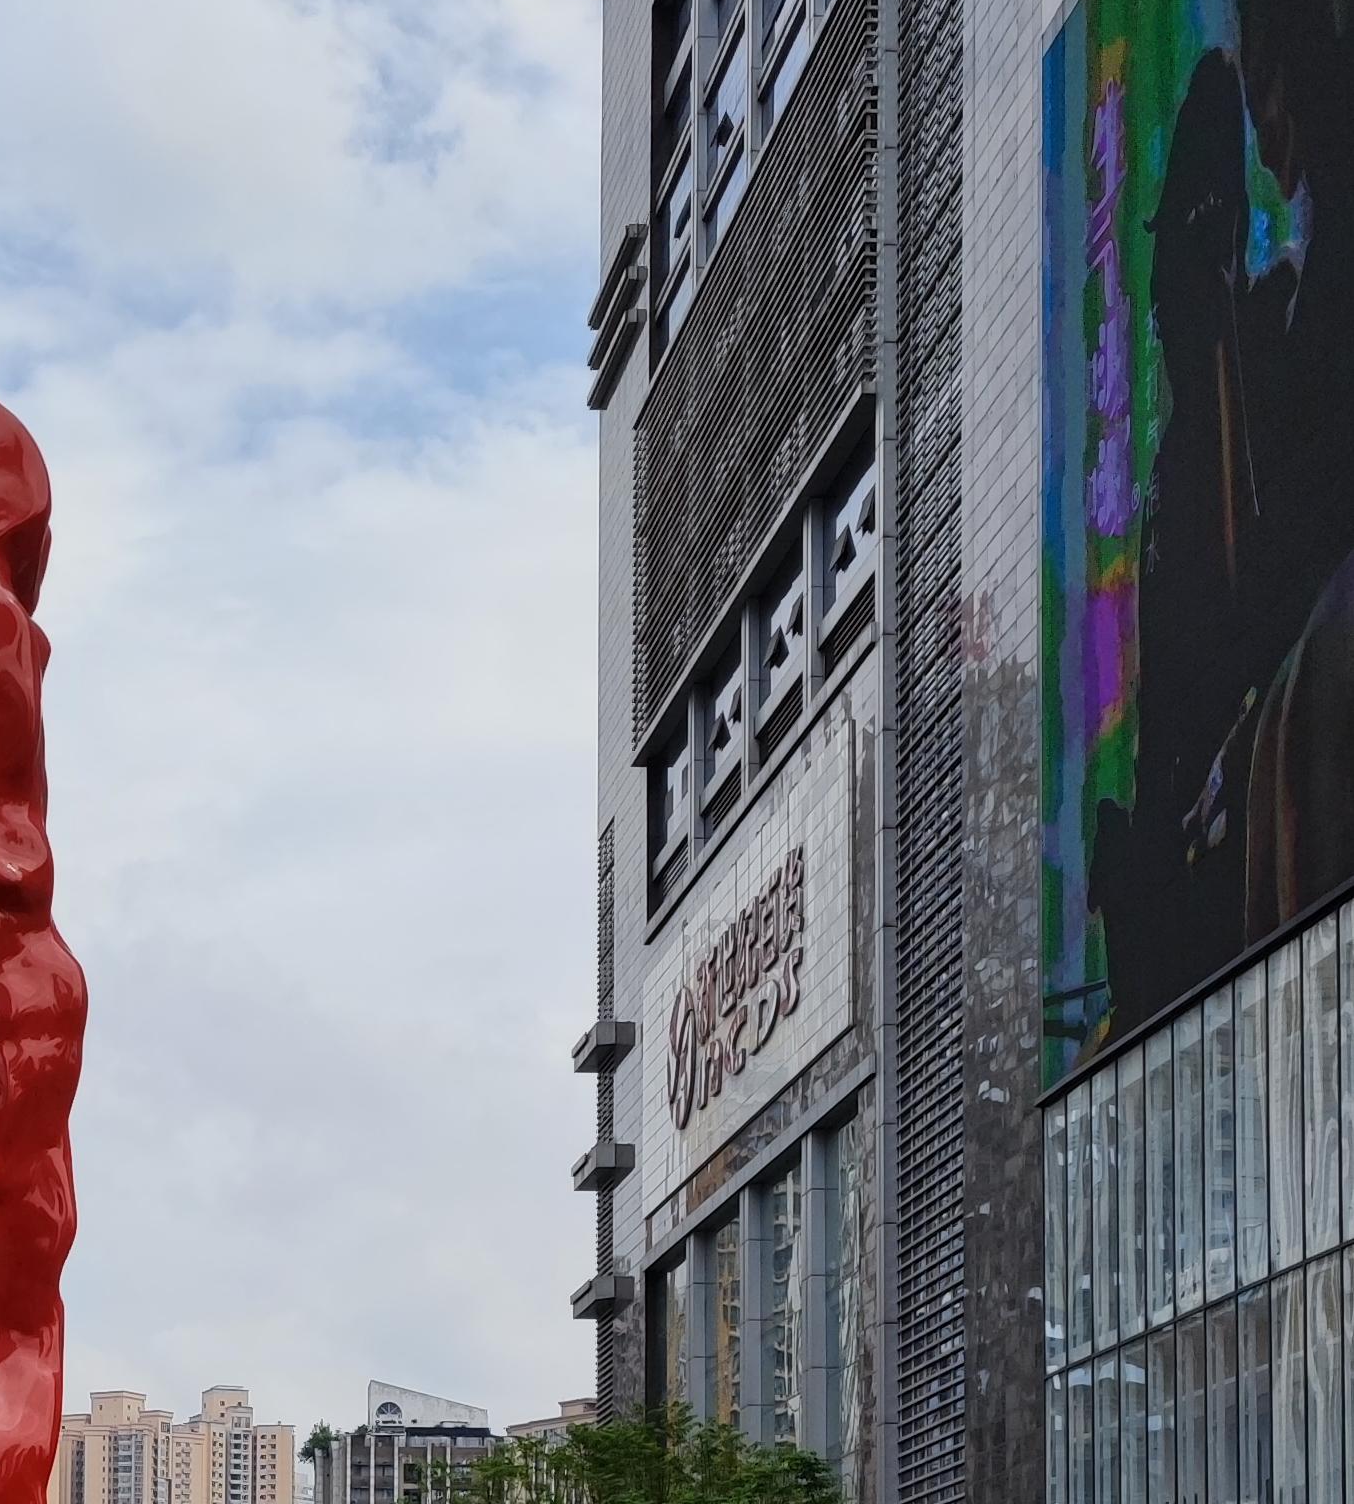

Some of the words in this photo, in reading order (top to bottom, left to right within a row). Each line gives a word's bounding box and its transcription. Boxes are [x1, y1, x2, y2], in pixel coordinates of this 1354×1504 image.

[695, 841, 805, 1046] 新世纪百货
